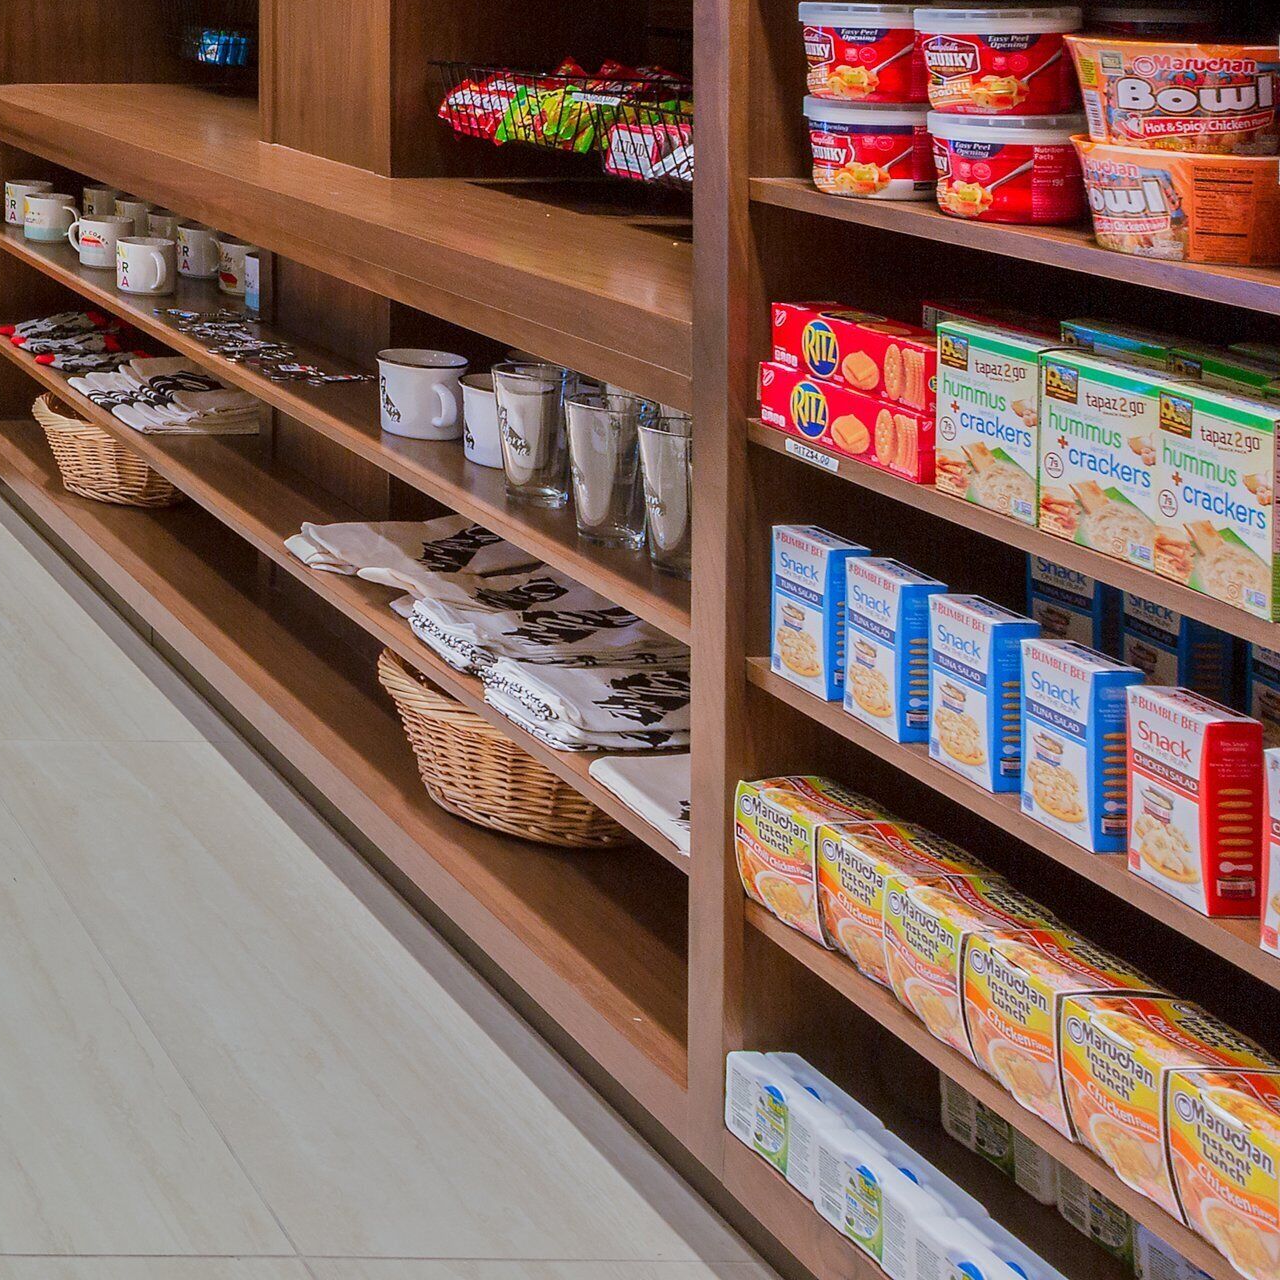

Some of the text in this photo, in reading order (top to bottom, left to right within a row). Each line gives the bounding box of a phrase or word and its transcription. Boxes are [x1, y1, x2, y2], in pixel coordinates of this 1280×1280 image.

[842, 34, 877, 42] Opening
[926, 50, 975, 68] CHUNKY
[1154, 56, 1257, 74] Maruchan
[1117, 73, 1274, 112] Bowl
[1145, 120, 1251, 134] Hot & Spicy Chicken
[957, 149, 989, 157] Opening
[972, 142, 990, 150] Peel
[1034, 153, 1054, 161] Facts
[804, 326, 837, 366] RITZ
[975, 359, 1026, 382] tapaz 2 go
[793, 387, 827, 426] RITZ
[943, 372, 1006, 412] hummus
[1086, 392, 1144, 417] tapaz 2 go
[960, 411, 1032, 448] crackers
[1049, 405, 1122, 449] hummus
[1200, 425, 1260, 453] tapaz 2 go
[1068, 448, 1151, 488] crackers
[1162, 439, 1237, 487] hummus
[1183, 485, 1266, 530] crackers
[781, 533, 823, 558] BUMBLE BEE
[780, 552, 819, 583] Snack
[854, 566, 897, 593] BUMBLE BEE
[780, 580, 819, 602] TUNA SALAD
[853, 584, 891, 617] Snack
[868, 620, 890, 639] SALAD
[938, 604, 987, 633] BUMBLE BEE
[938, 624, 980, 658] Snack
[956, 662, 980, 682] SALAD
[1031, 649, 1086, 682] BUMBLE BEE
[1031, 670, 1081, 710] Snack
[1032, 704, 1079, 733] TUNA SALAD
[1139, 698, 1200, 733] BUMBLE BEE
[1138, 720, 1192, 763] Snack
[1133, 753, 1198, 791] CHICKEN SALAD
[752, 796, 807, 841] Maruchan
[755, 815, 793, 846] Instant
[759, 828, 789, 855] Lunch
[837, 862, 876, 897] Instant
[841, 876, 871, 907] Lunch
[900, 896, 955, 949] Maruchan
[906, 931, 935, 962] Lunch
[983, 952, 1047, 1013] Maruchan
[986, 975, 1031, 1015] Instant
[991, 991, 1027, 1025] Lunch
[987, 1009, 1031, 1045] Chicken
[1083, 1024, 1153, 1089] Maruchan
[1086, 1046, 1135, 1091] Instant
[1090, 1065, 1130, 1102] Lunch
[1087, 1083, 1135, 1126] Chicken
[1190, 1100, 1273, 1171] Maruchan
[1196, 1124, 1252, 1177] Instant
[1202, 1145, 1245, 1186] Lunch
[1198, 1163, 1251, 1214] Chicken
